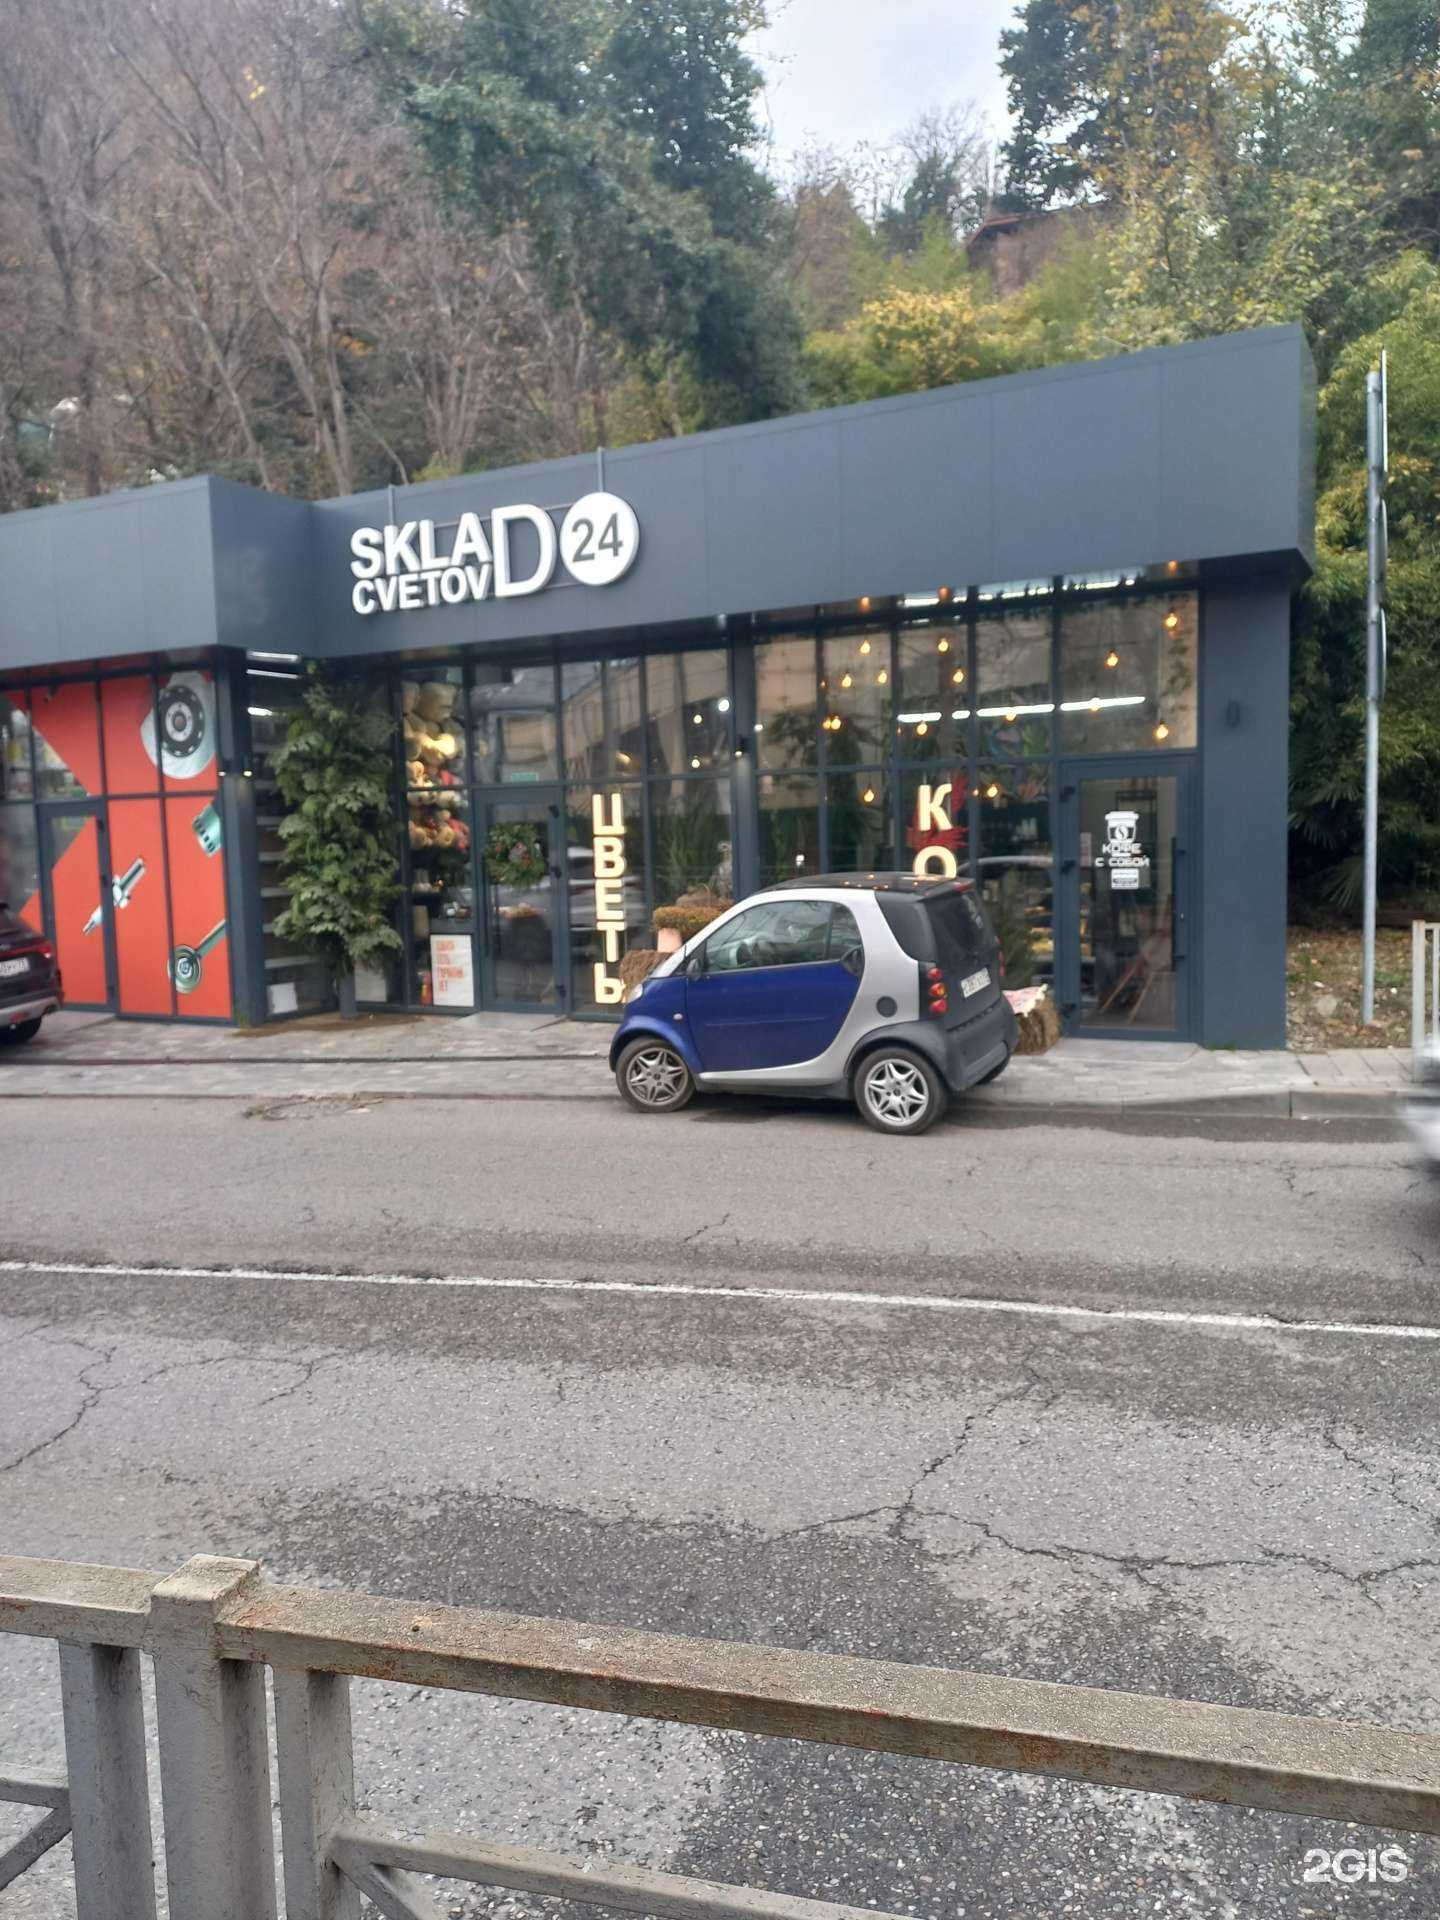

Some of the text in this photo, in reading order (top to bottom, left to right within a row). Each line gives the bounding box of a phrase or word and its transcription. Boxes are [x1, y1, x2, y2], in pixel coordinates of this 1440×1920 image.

[351, 503, 624, 598] SKLAD 24
[351, 563, 492, 615] CVETOV
[1102, 842, 1142, 854] КОФЕ
